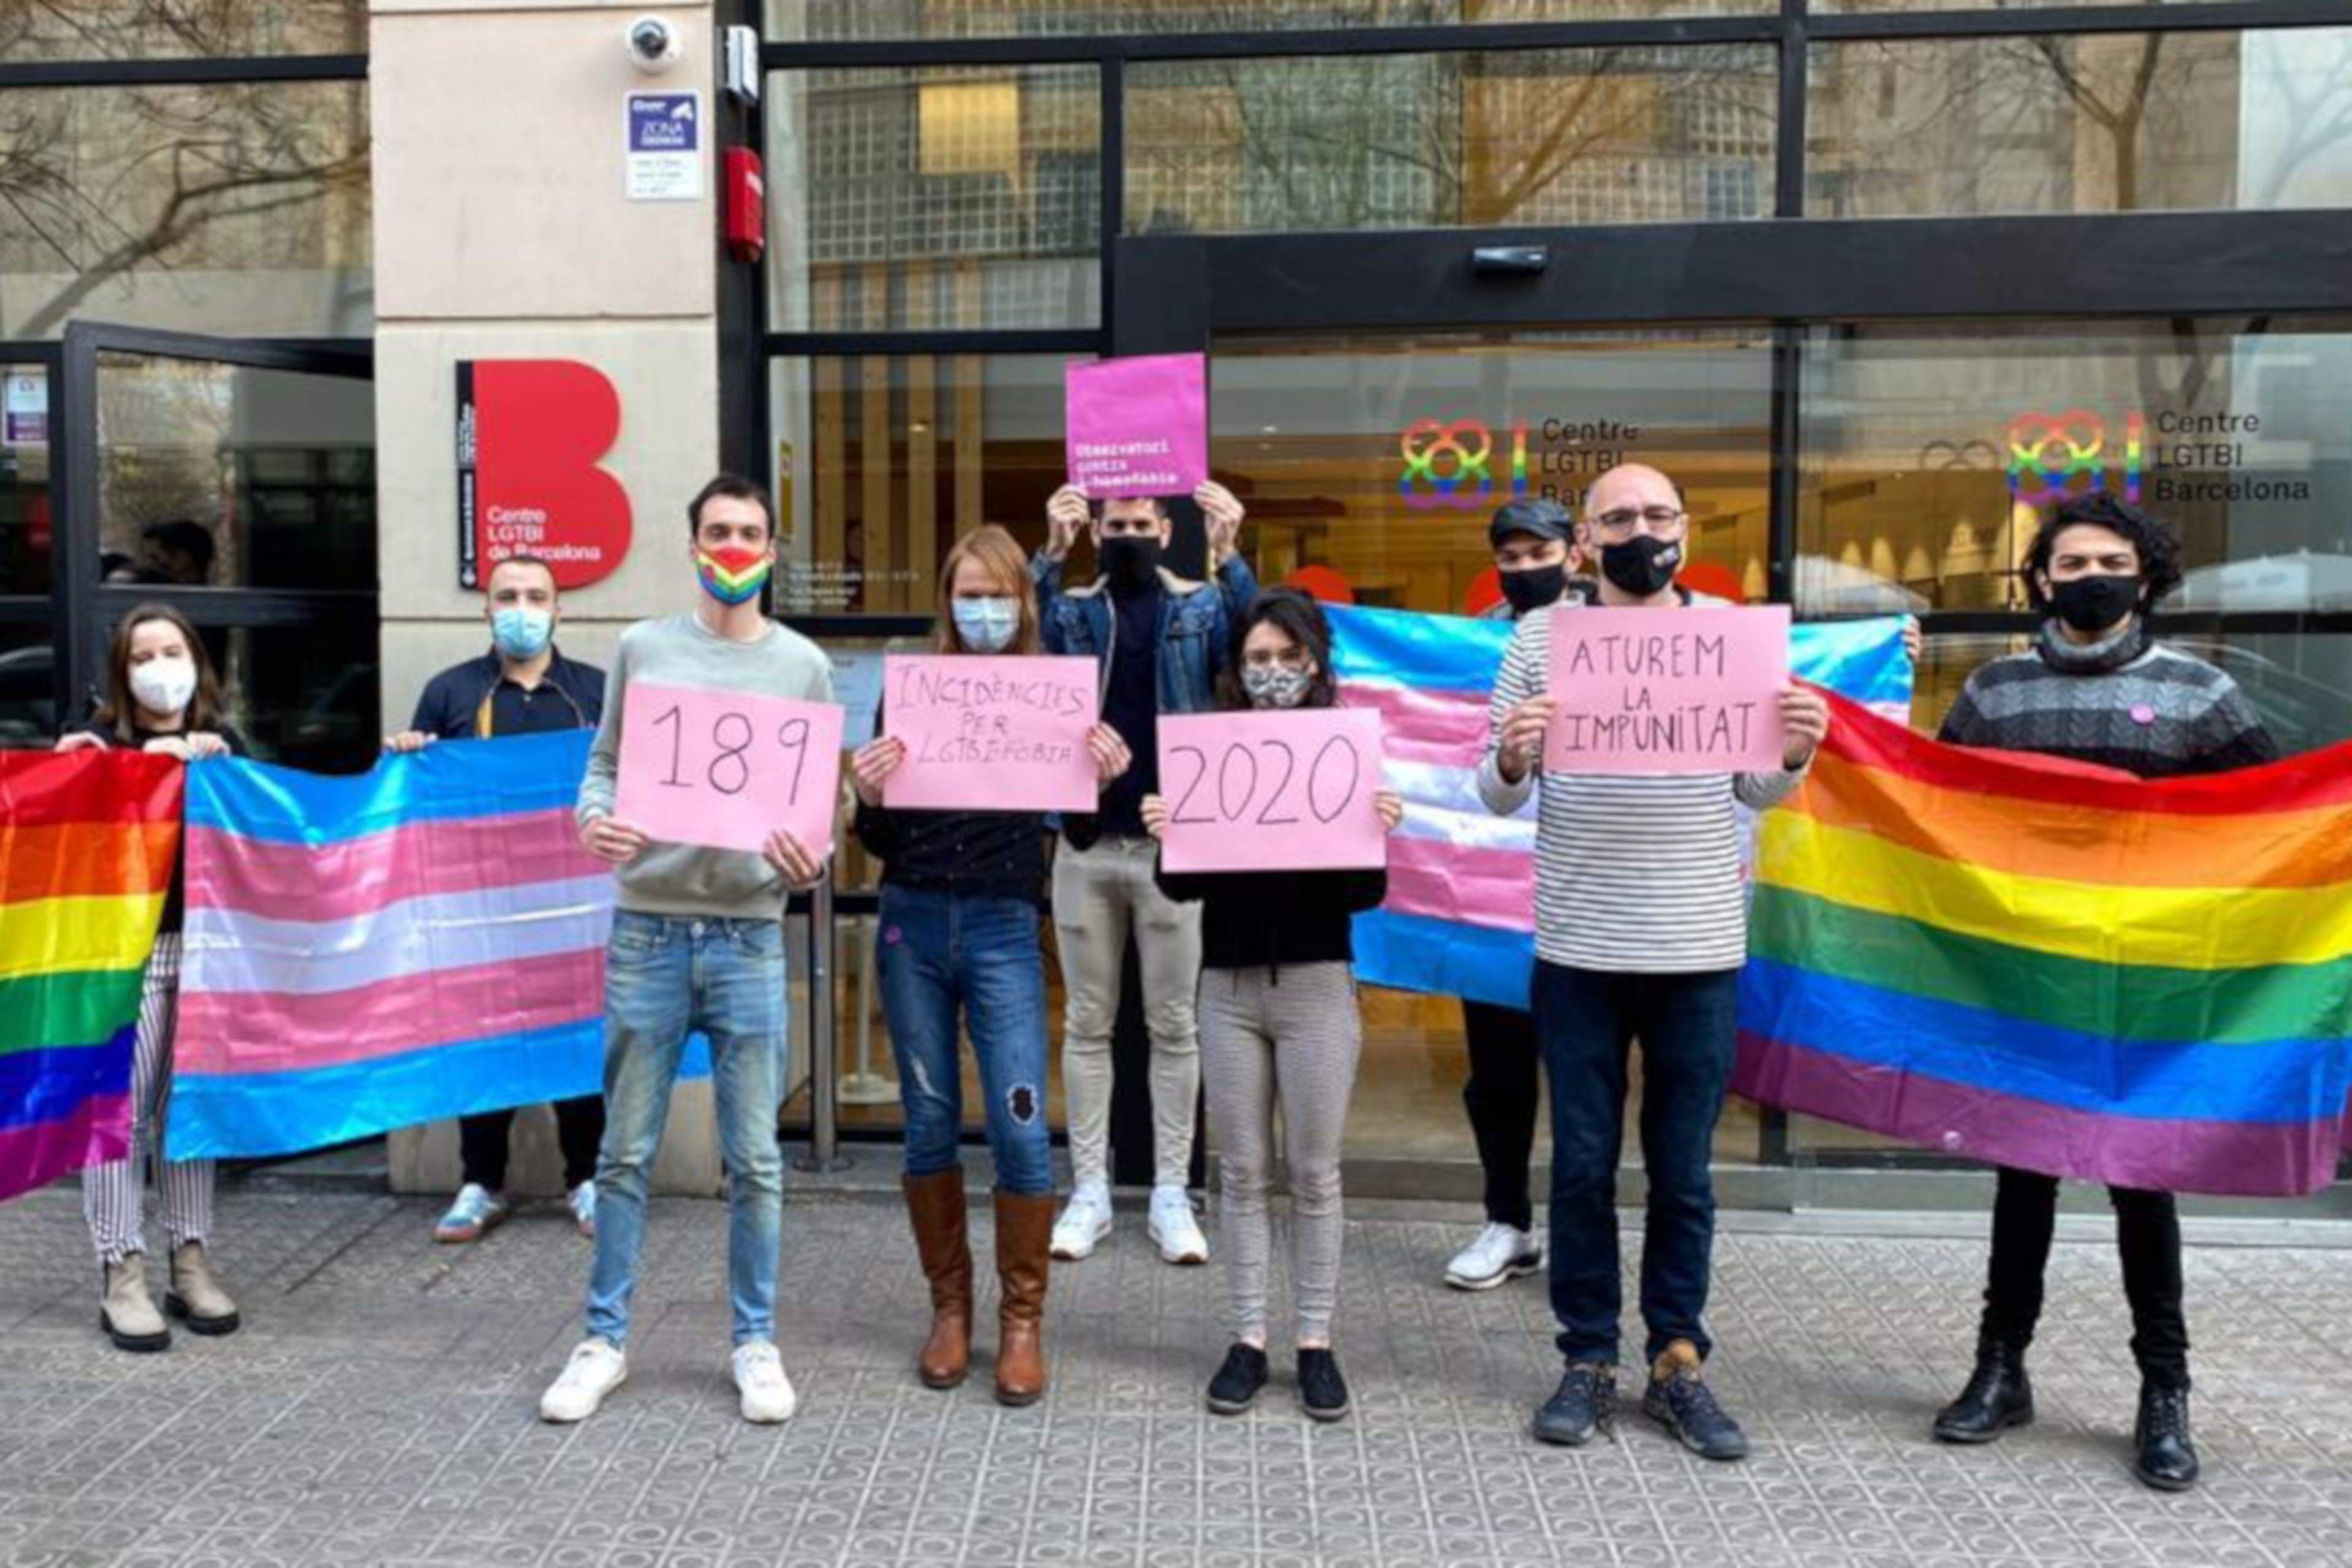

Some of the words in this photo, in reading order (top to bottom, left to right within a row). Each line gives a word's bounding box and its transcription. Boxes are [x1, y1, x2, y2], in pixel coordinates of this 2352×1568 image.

[1543, 418, 1638, 440] Centre
[2158, 411, 2260, 433] Centre
[2157, 443, 2242, 468] LGTBI
[2156, 476, 2309, 500] Barcelona
[487, 505, 546, 523] Centre
[487, 525, 544, 542] LGTBI
[1570, 634, 1725, 677] ATUREM
[1623, 685, 1651, 711] LA
[961, 711, 1008, 735] PER
[652, 705, 809, 806] 189
[1170, 734, 1359, 825] 2020
